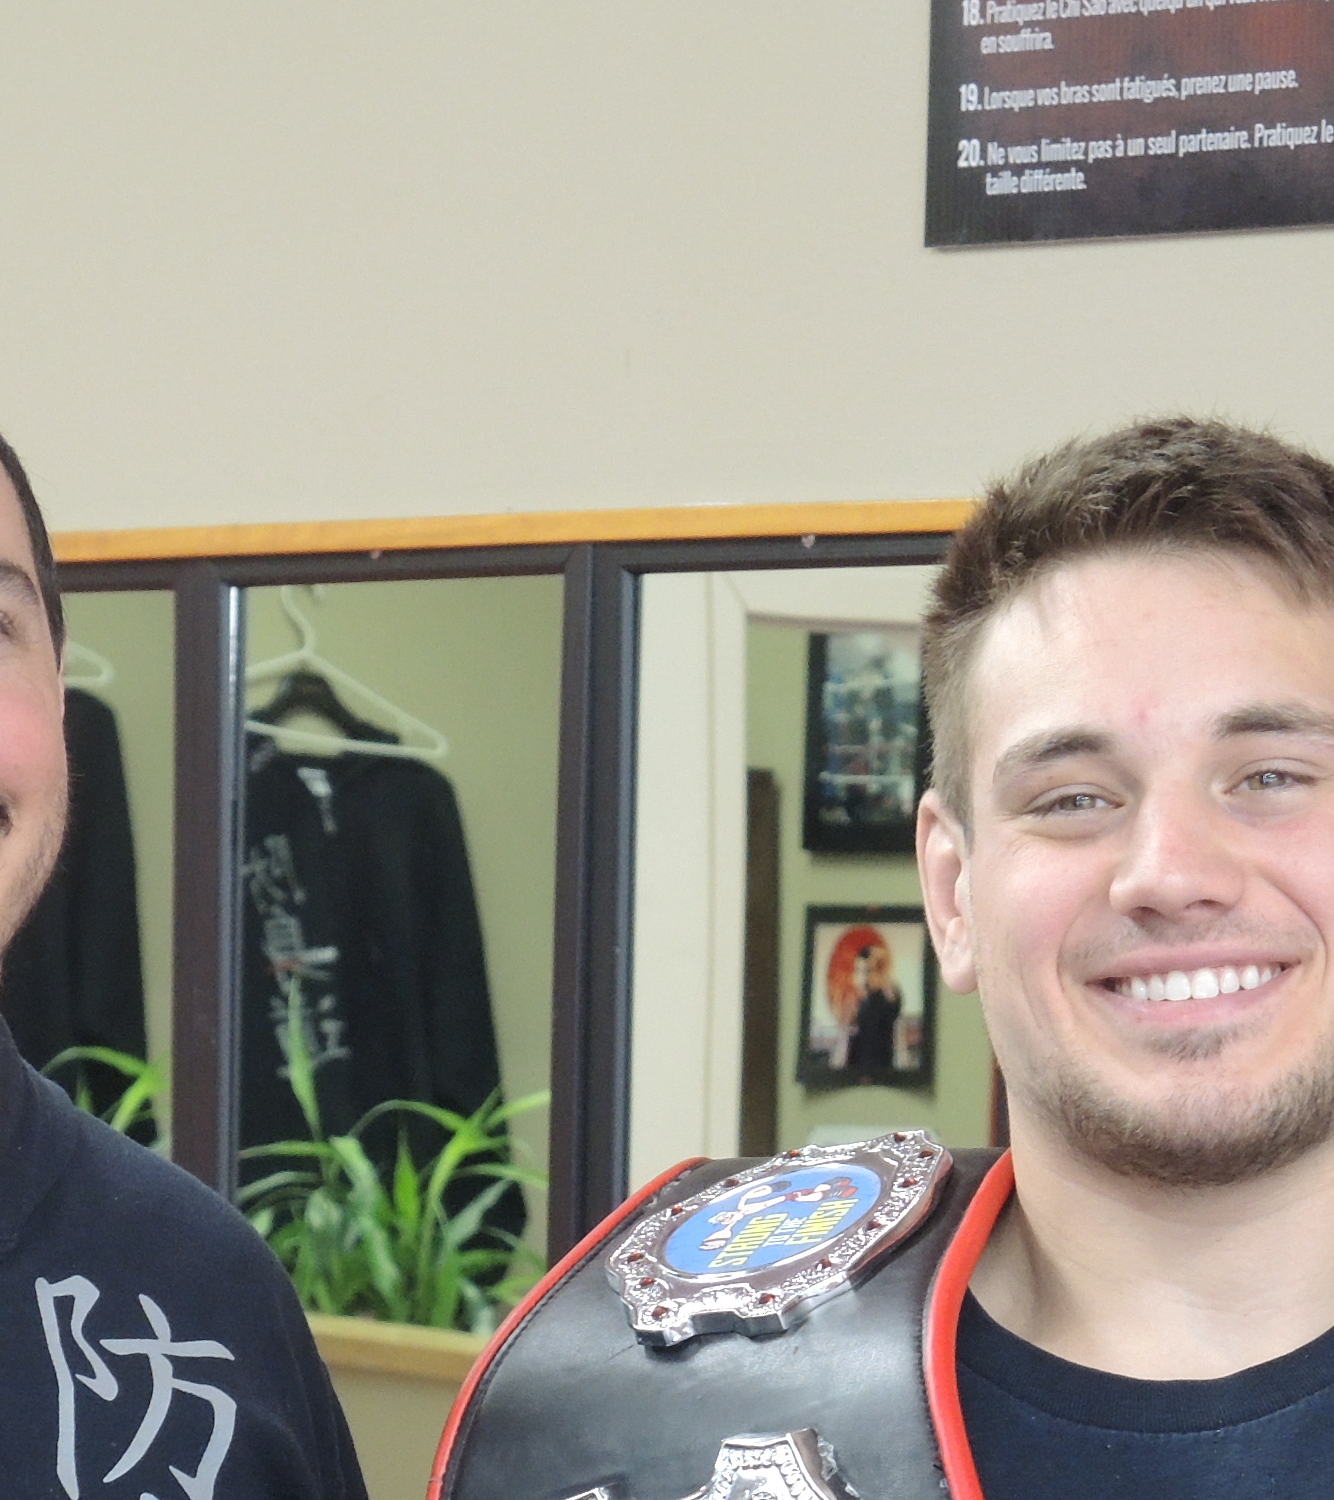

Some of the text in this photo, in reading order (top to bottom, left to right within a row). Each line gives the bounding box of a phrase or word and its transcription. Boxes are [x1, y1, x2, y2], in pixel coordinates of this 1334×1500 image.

[986, 0, 1045, 26] Pratiquez
[1046, 0, 1058, 19] le
[980, 36, 997, 54] en
[959, 70, 1299, 111] 19. Lorsque vos bras sont fatigués, prenez une pause.
[957, 138, 985, 168] 20.
[987, 141, 1005, 166] Ne
[1008, 144, 1039, 164] vous
[1041, 137, 1086, 162] limitez
[1087, 139, 1112, 164] pas
[1115, 133, 1125, 157] à
[1127, 137, 1145, 156] un
[1147, 129, 1176, 155] seul
[1179, 126, 1251, 157] partenaire.
[1254, 122, 1318, 150] Pratiquez
[1321, 119, 1334, 143] le
[986, 167, 1087, 196] taille différente.
[707, 1212, 789, 1269] STRONG
[784, 1198, 859, 1246] FINISH
